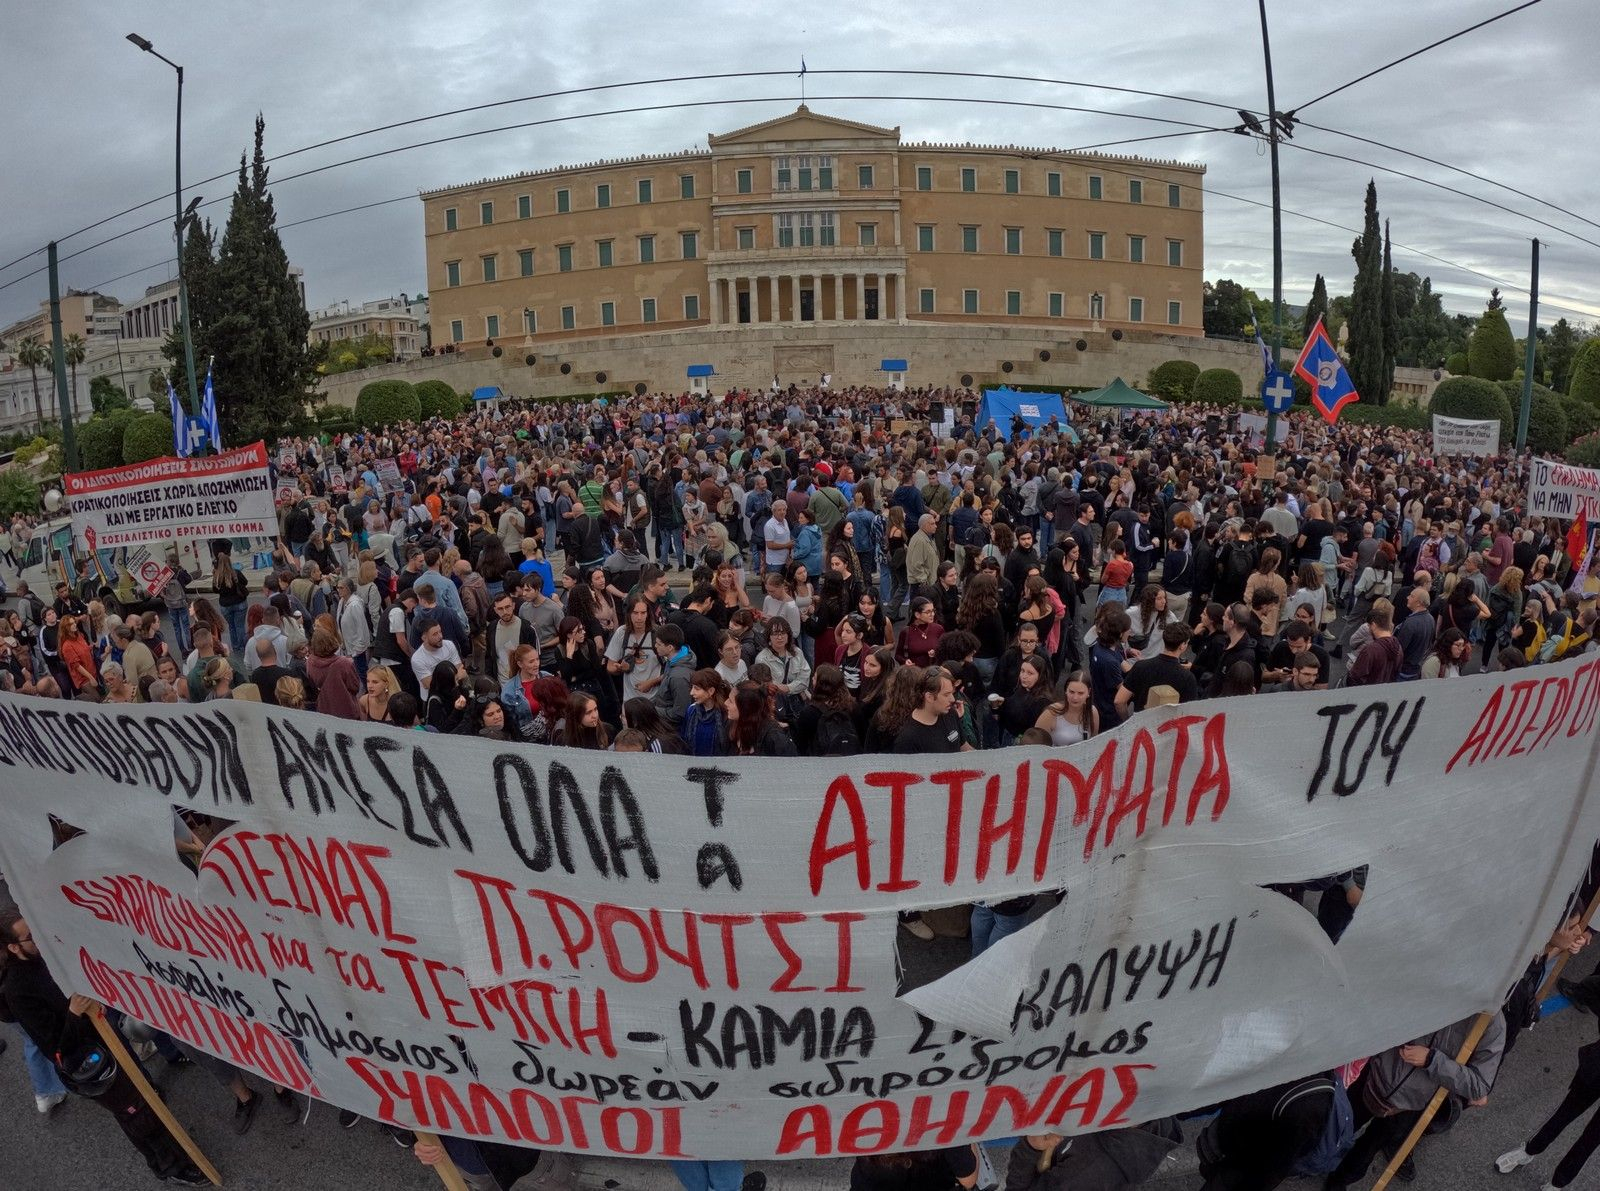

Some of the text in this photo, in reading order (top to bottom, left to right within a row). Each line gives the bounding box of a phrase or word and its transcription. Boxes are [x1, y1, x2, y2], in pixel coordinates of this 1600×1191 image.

[71, 478, 84, 490] ΟΙ
[86, 460, 188, 488] ΙΔΙΩΤΙΚΟΠΟΙΗΣΕΙΣ
[189, 450, 259, 472] ΣΚΟΤΩΝΟΥΝ
[1535, 461, 1548, 486] ΤΟ
[71, 487, 162, 514] ΚΡΑΤΙΚΟΠΟΙΗΣΕΙΣ
[164, 483, 197, 501] ΧΩΡΙΣ
[197, 475, 269, 497] ΑΠΟΖΗΜΙΩΣΗ
[106, 499, 238, 527] ΚΑΙ ΜΕ ΕΡΓΑΤΙΚΟ ΕΛΕΓΧΟ
[1533, 490, 1546, 511] ΝΑ
[1548, 491, 1573, 514] ΜΗΝ
[101, 521, 265, 545] ΣΟΣΙΑΛΙΣΤΙΚΟ ΕΡΓΑΤΙΚΟ ΚΟΜΜΑ
[493, 752, 661, 884] ΟΛΑ
[809, 712, 1231, 897] ΑΙΤΗΜΑΤΑ
[1307, 696, 1426, 802] ΤΟΥ
[454, 868, 867, 993] Π.ΡΟΥΤΣΙ
[61, 874, 267, 978] ΔΙΚΑΙΟΣΥΝΗ
[381, 948, 618, 1059] ΤΕΜΠΗ
[680, 999, 876, 1070] ΚΑΜΙΑ
[511, 1039, 719, 1104] δωρεάν
[769, 1021, 1153, 1099] σιδηρόδρομος
[345, 1056, 699, 1158] ΣΥΛΛΟΓΟΙ
[775, 1063, 1157, 1156] ΑΘΗΝΑΣ
